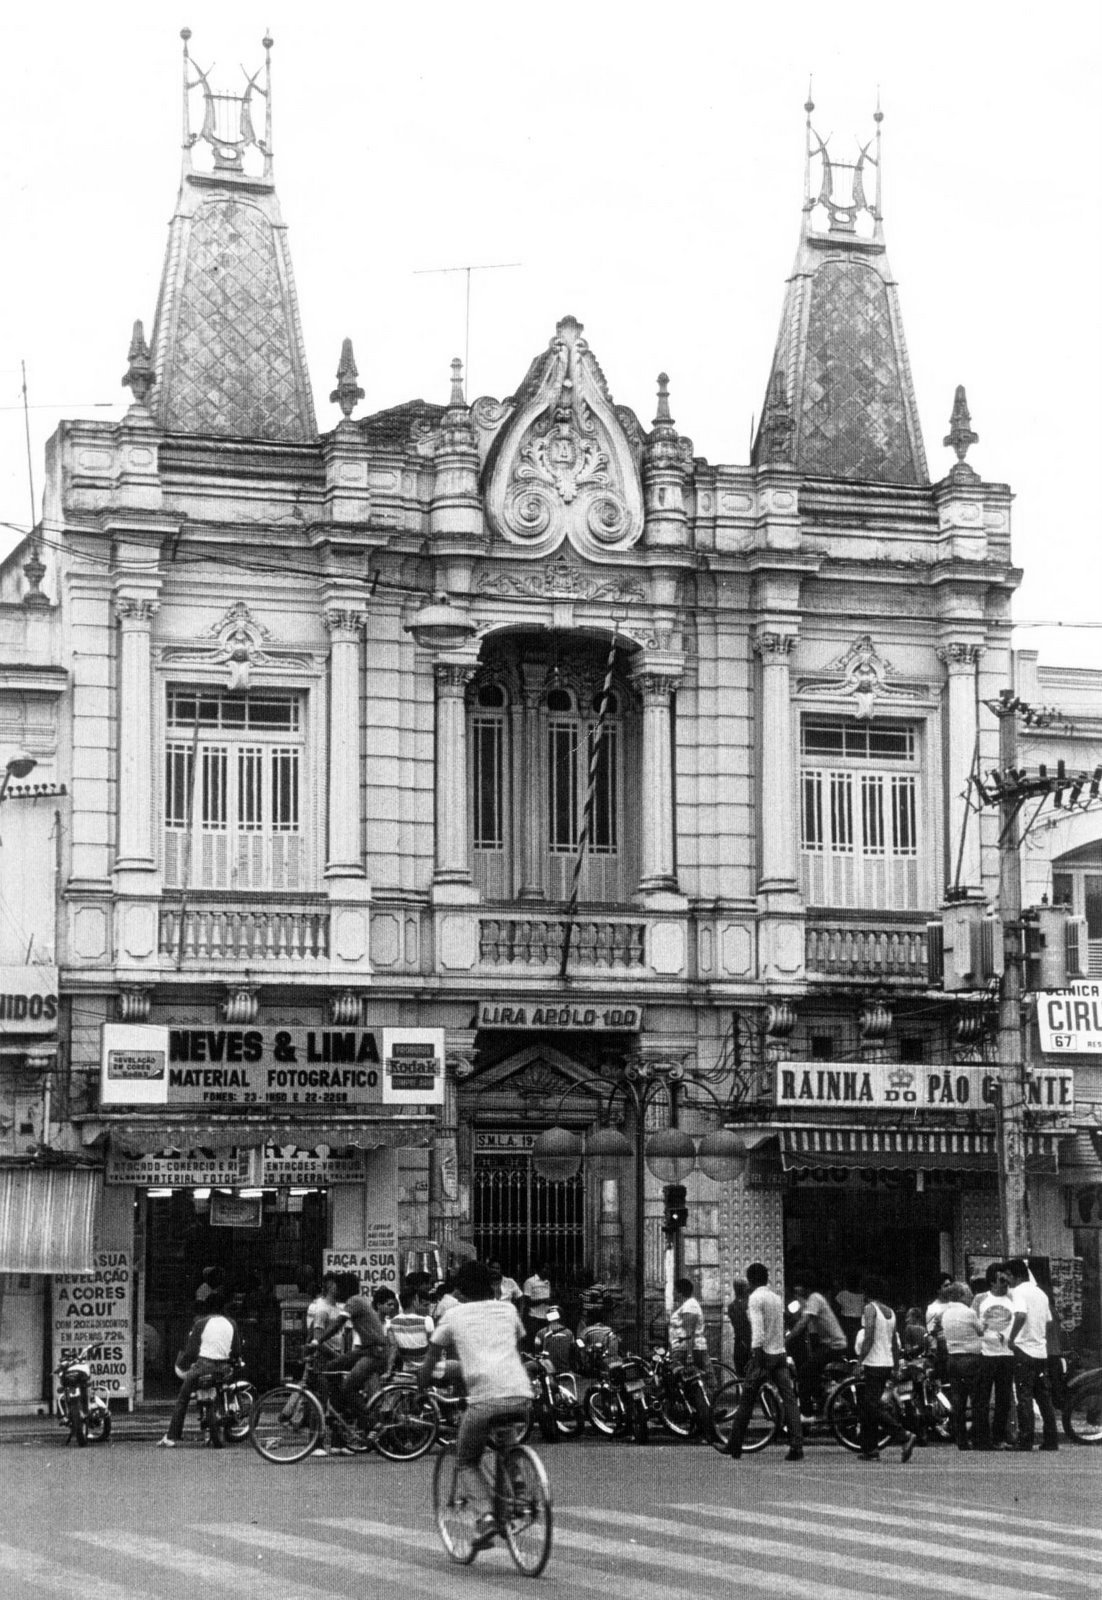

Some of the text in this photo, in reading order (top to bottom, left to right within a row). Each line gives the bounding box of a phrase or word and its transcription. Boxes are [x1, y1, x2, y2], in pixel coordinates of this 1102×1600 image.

[481, 1007, 527, 1025] LIRA
[169, 1030, 380, 1063] NEVES & LIMA
[1055, 1035, 1071, 1047] 67
[113, 1056, 156, 1065] REVELAÇÃO
[389, 1060, 437, 1074] Kodak
[169, 1068, 251, 1088] MATERIAL
[781, 1070, 874, 1101] RAINHA
[884, 1090, 917, 1102] DO
[927, 1070, 970, 1103] PÃO
[293, 1092, 299, 1102] E
[99, 1254, 127, 1267] SUA
[327, 1254, 396, 1268] FAÇA A SUA
[59, 1286, 126, 1301] A CORES
[90, 1363, 127, 1375] ABAIXO
